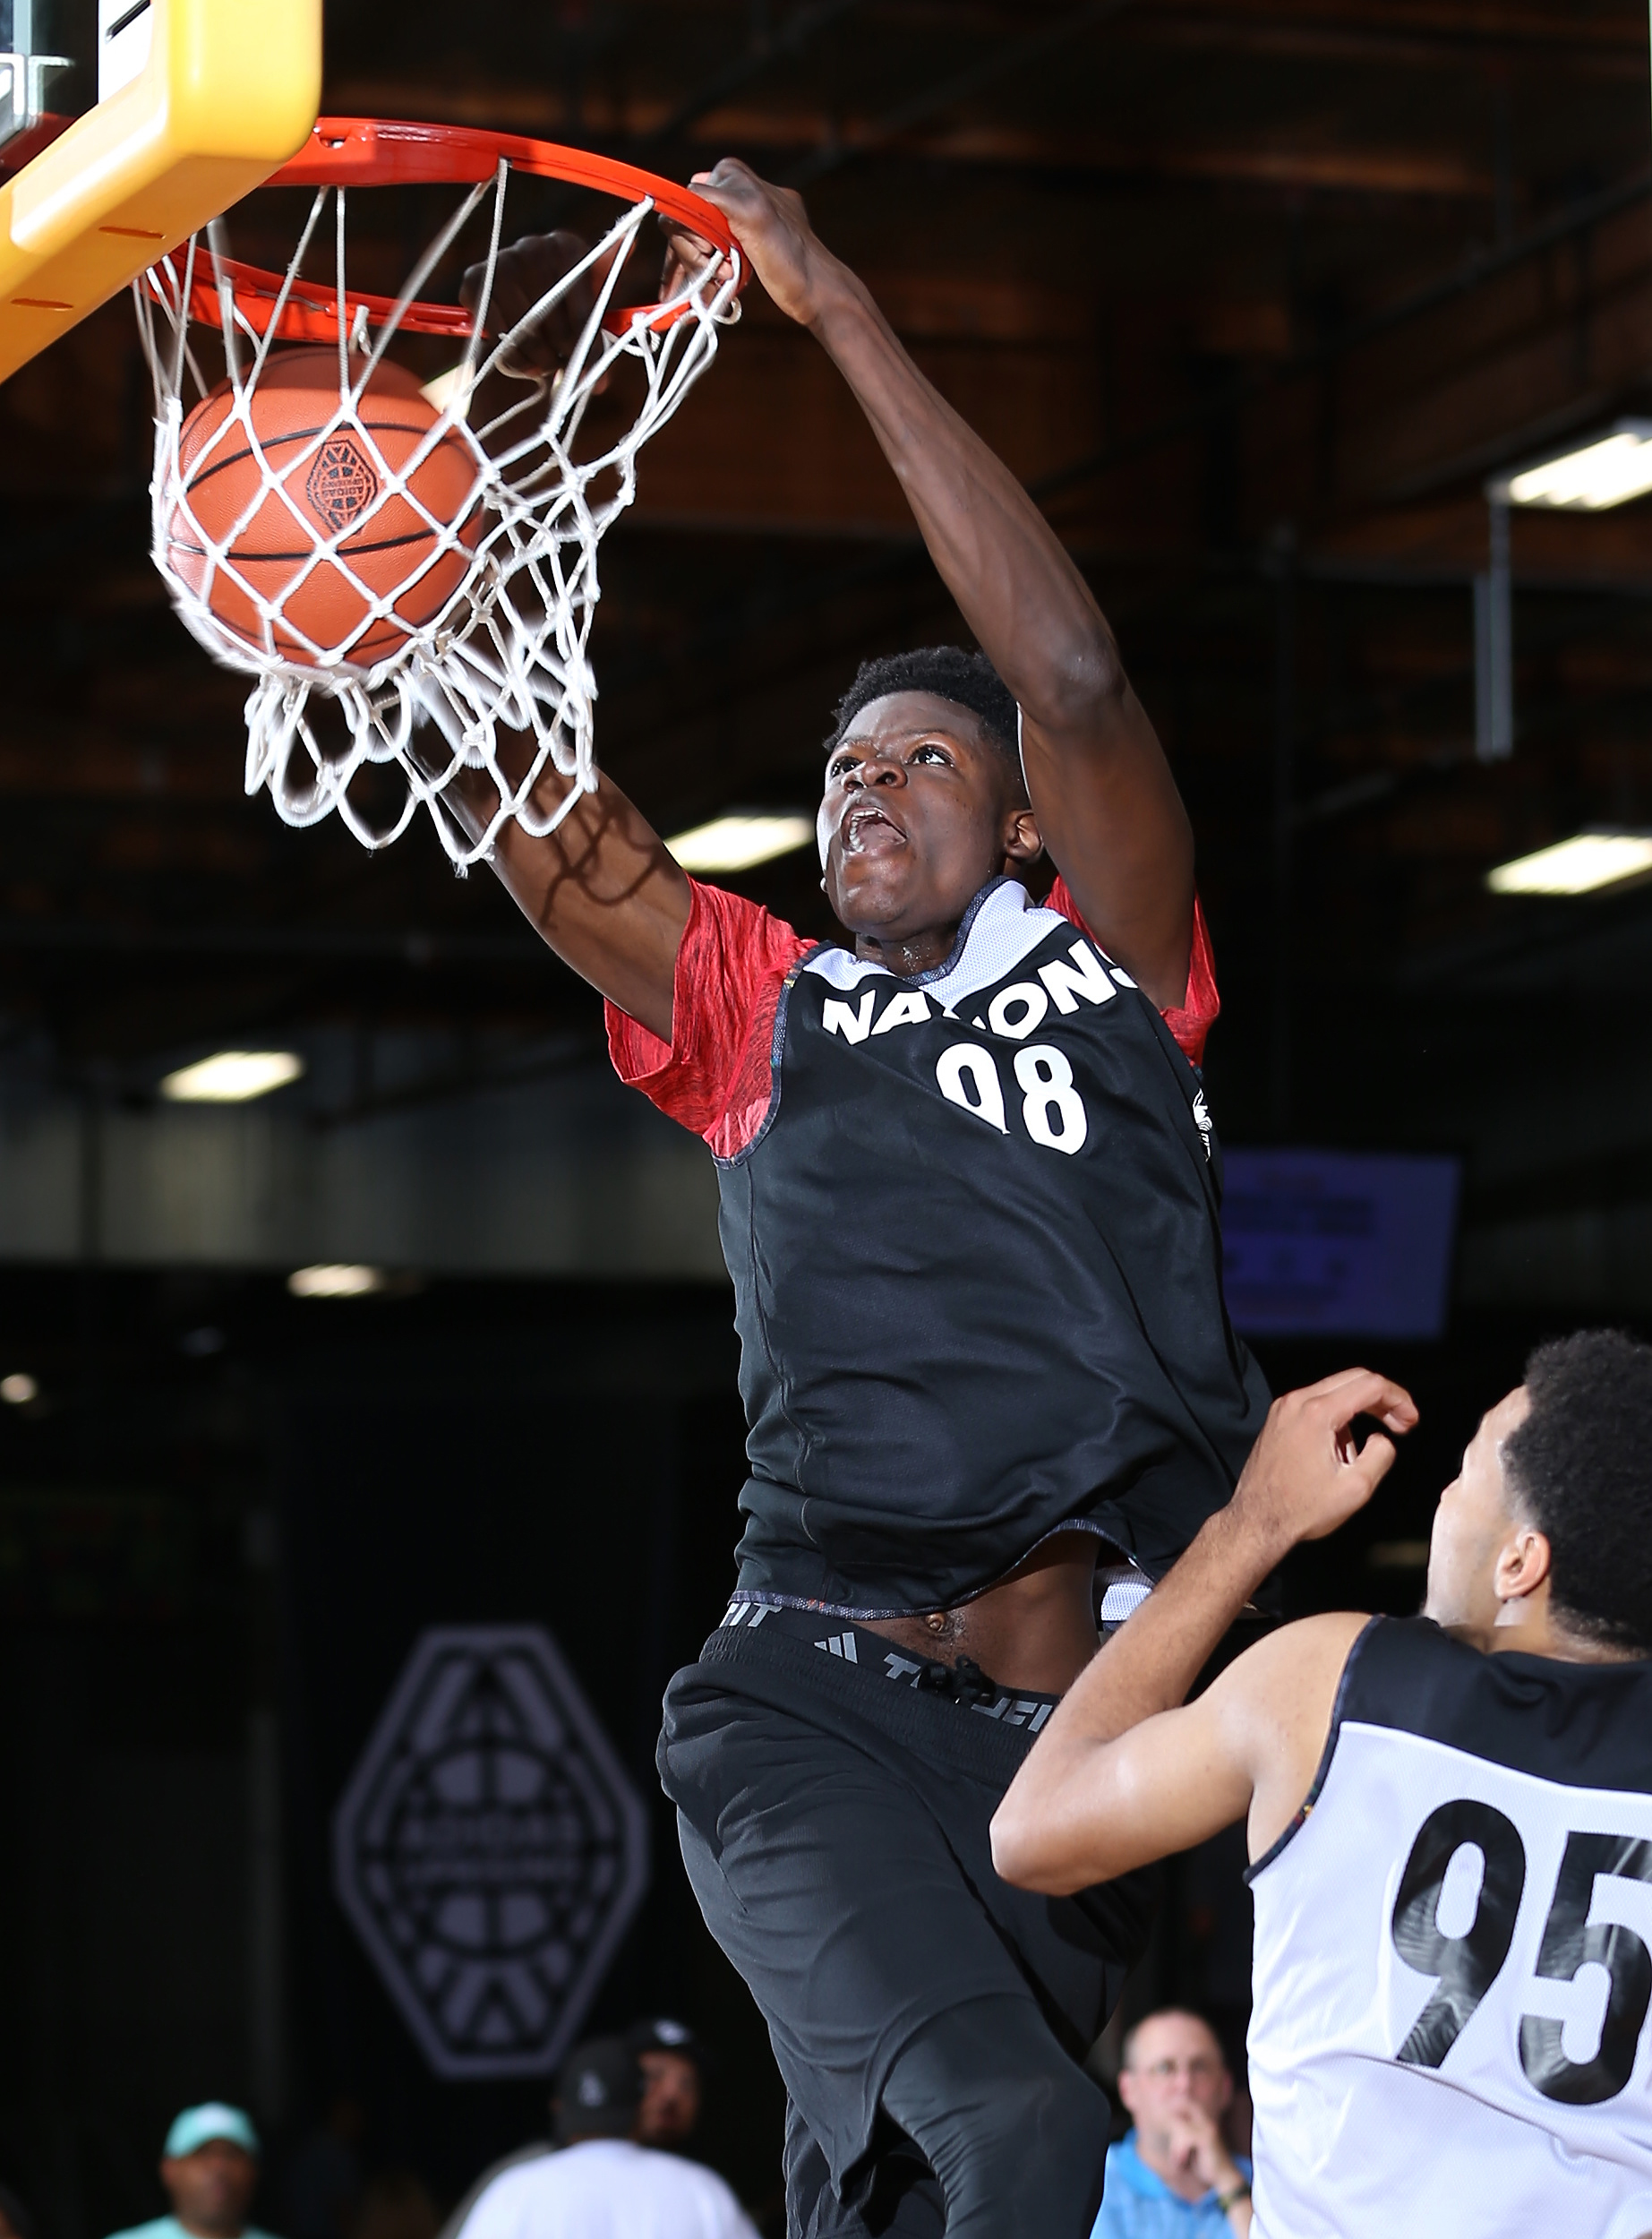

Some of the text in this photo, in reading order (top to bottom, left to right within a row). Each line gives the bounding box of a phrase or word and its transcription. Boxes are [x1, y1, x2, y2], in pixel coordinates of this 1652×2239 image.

[823, 939, 1138, 1045] NAON
[936, 1042, 1089, 1155] 08
[1391, 1798, 1652, 2106] 95
